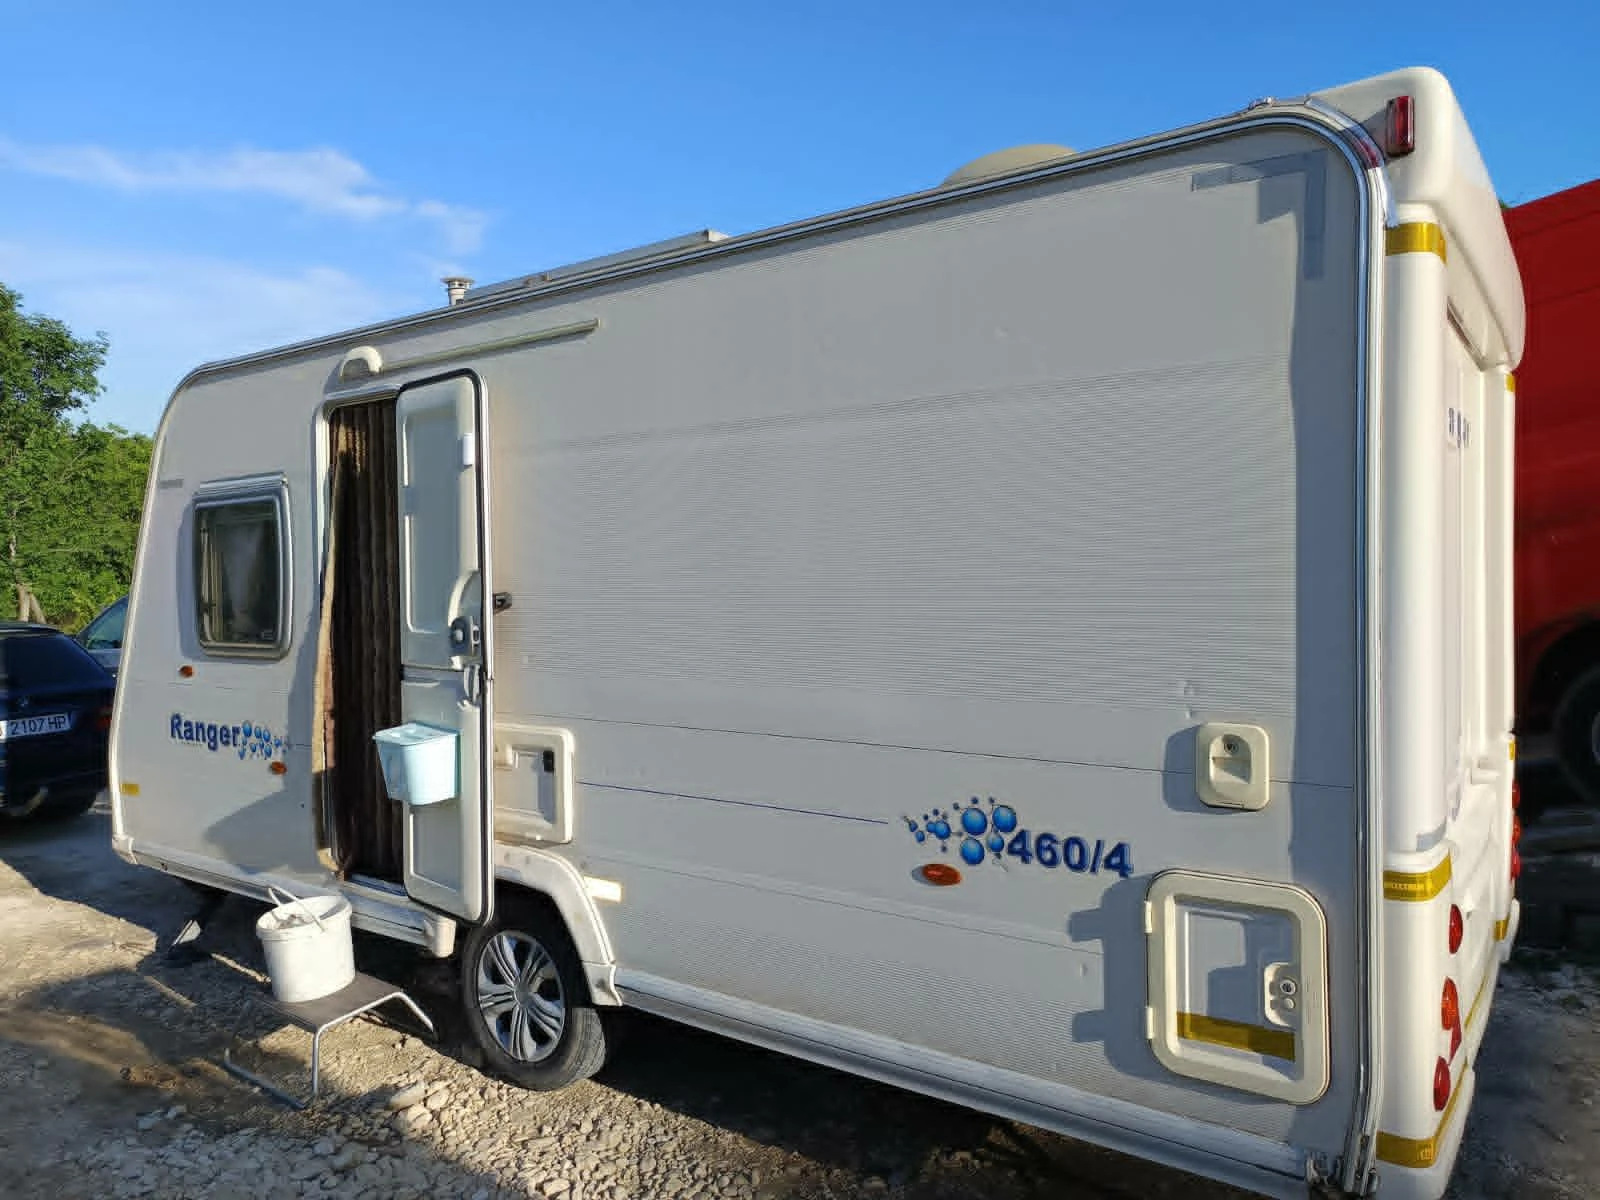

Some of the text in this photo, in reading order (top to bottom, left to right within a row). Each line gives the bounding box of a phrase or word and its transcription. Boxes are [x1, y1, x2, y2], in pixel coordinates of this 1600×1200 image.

[11, 719, 45, 735] 2107
[170, 713, 241, 752] Ranger
[1007, 829, 1134, 878] 460/4
